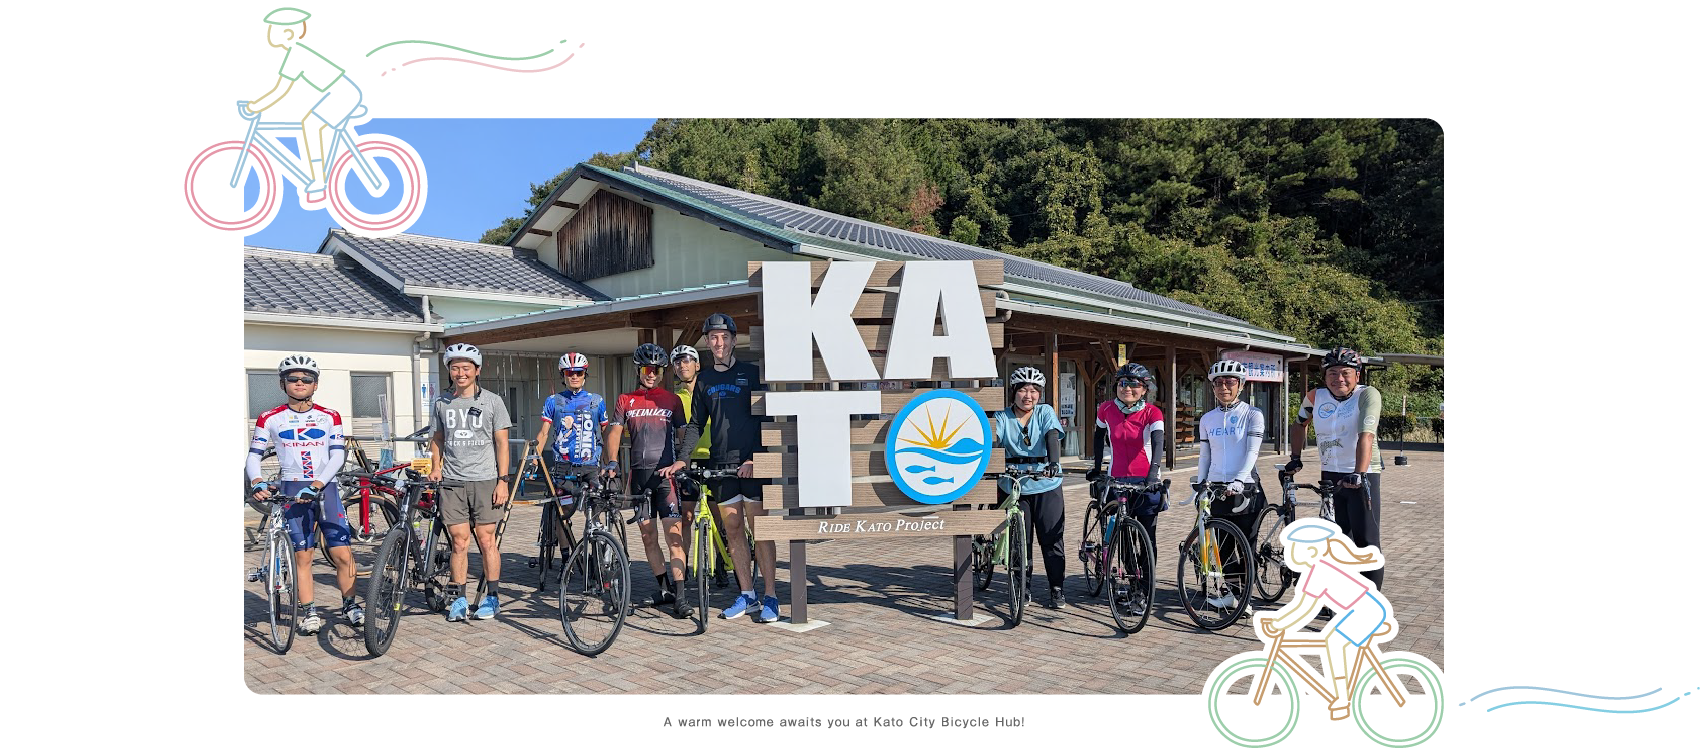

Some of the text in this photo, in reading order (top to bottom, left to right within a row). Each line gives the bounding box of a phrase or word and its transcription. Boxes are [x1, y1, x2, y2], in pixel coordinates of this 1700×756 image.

[707, 384, 741, 395] COUGARS
[445, 408, 483, 428] BYU
[626, 408, 673, 418] SPECIALIZED
[1209, 426, 1243, 436] HEART
[818, 519, 944, 533] RIDE KATO Project
